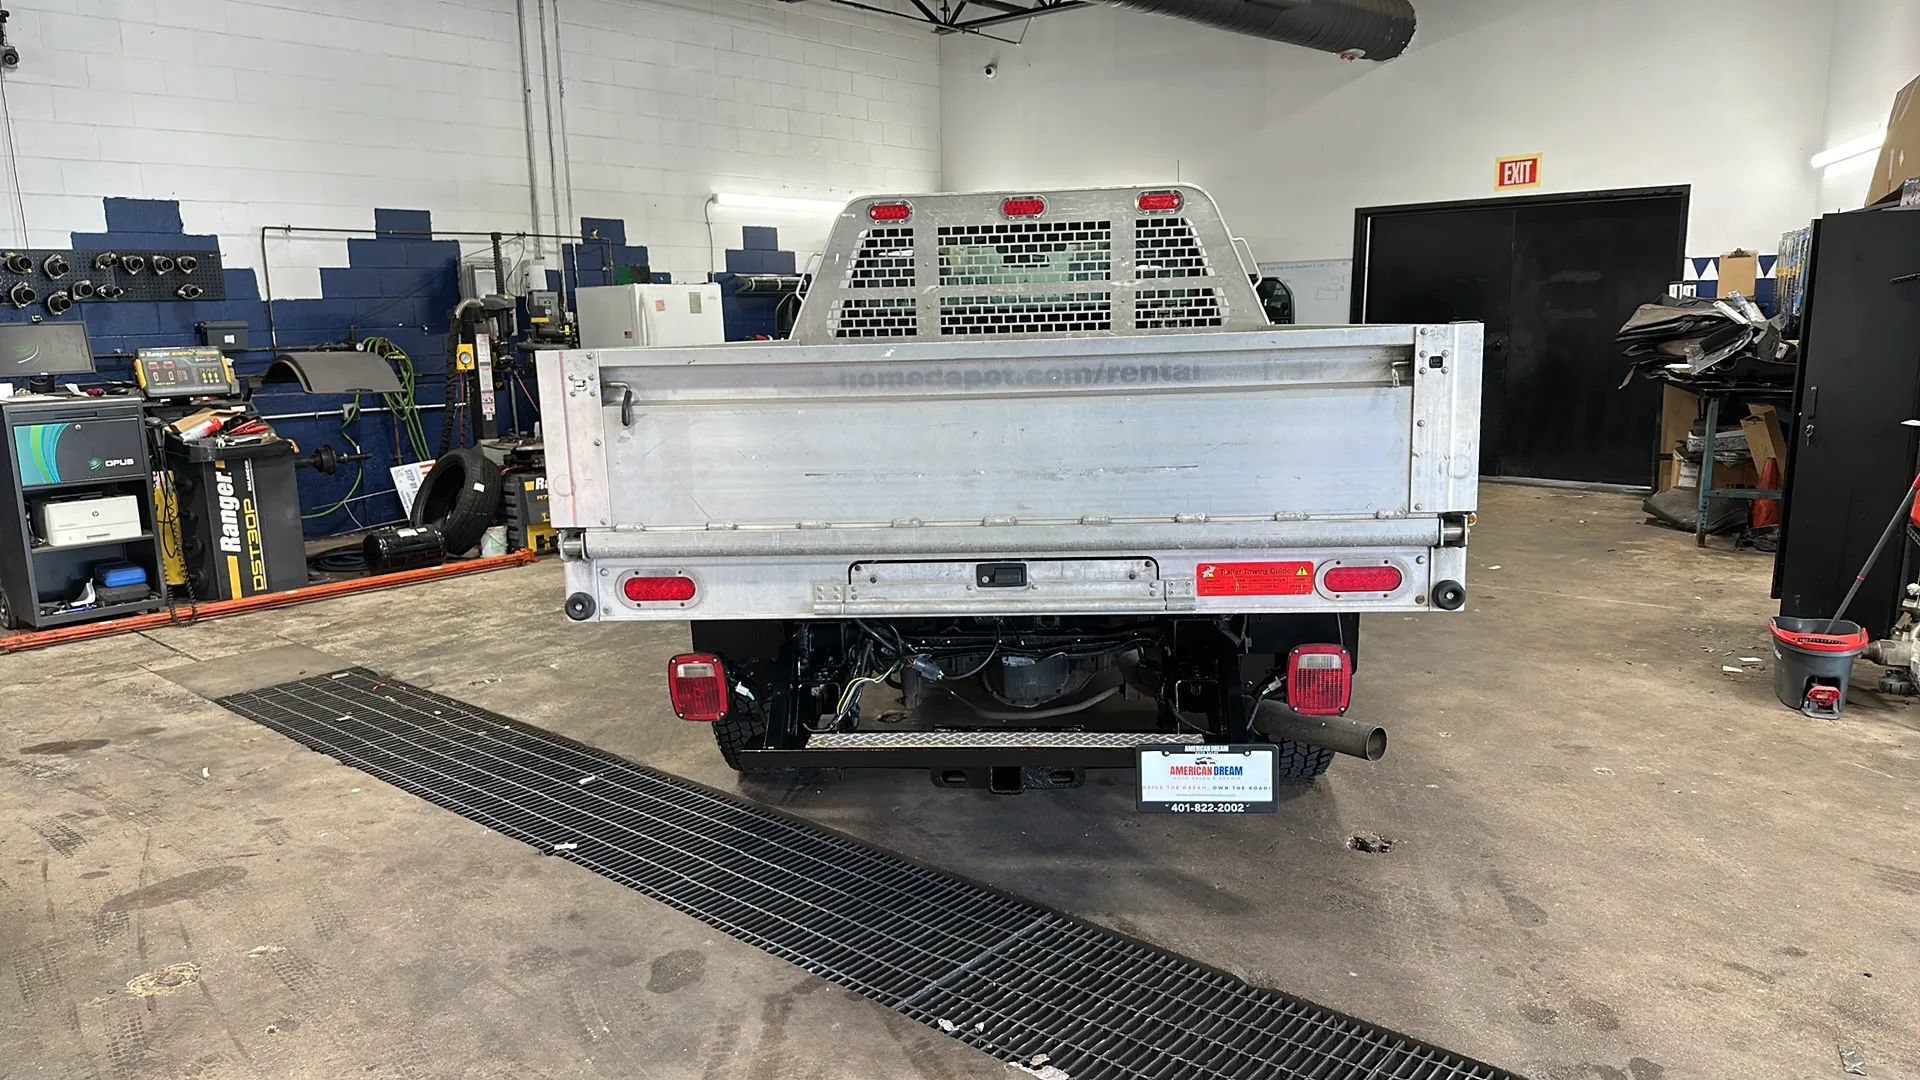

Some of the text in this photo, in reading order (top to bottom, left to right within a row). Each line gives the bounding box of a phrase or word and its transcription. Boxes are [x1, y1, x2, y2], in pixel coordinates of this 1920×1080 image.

[1503, 160, 1533, 185] EXIT
[105, 458, 134, 467] OPUS
[243, 498, 265, 592] DST30P
[1243, 567, 1269, 576] Towing
[1270, 567, 1292, 575] Guide
[1169, 766, 1243, 776] AMERICAN DREAM
[1171, 803, 1245, 813] 401-822-2002
